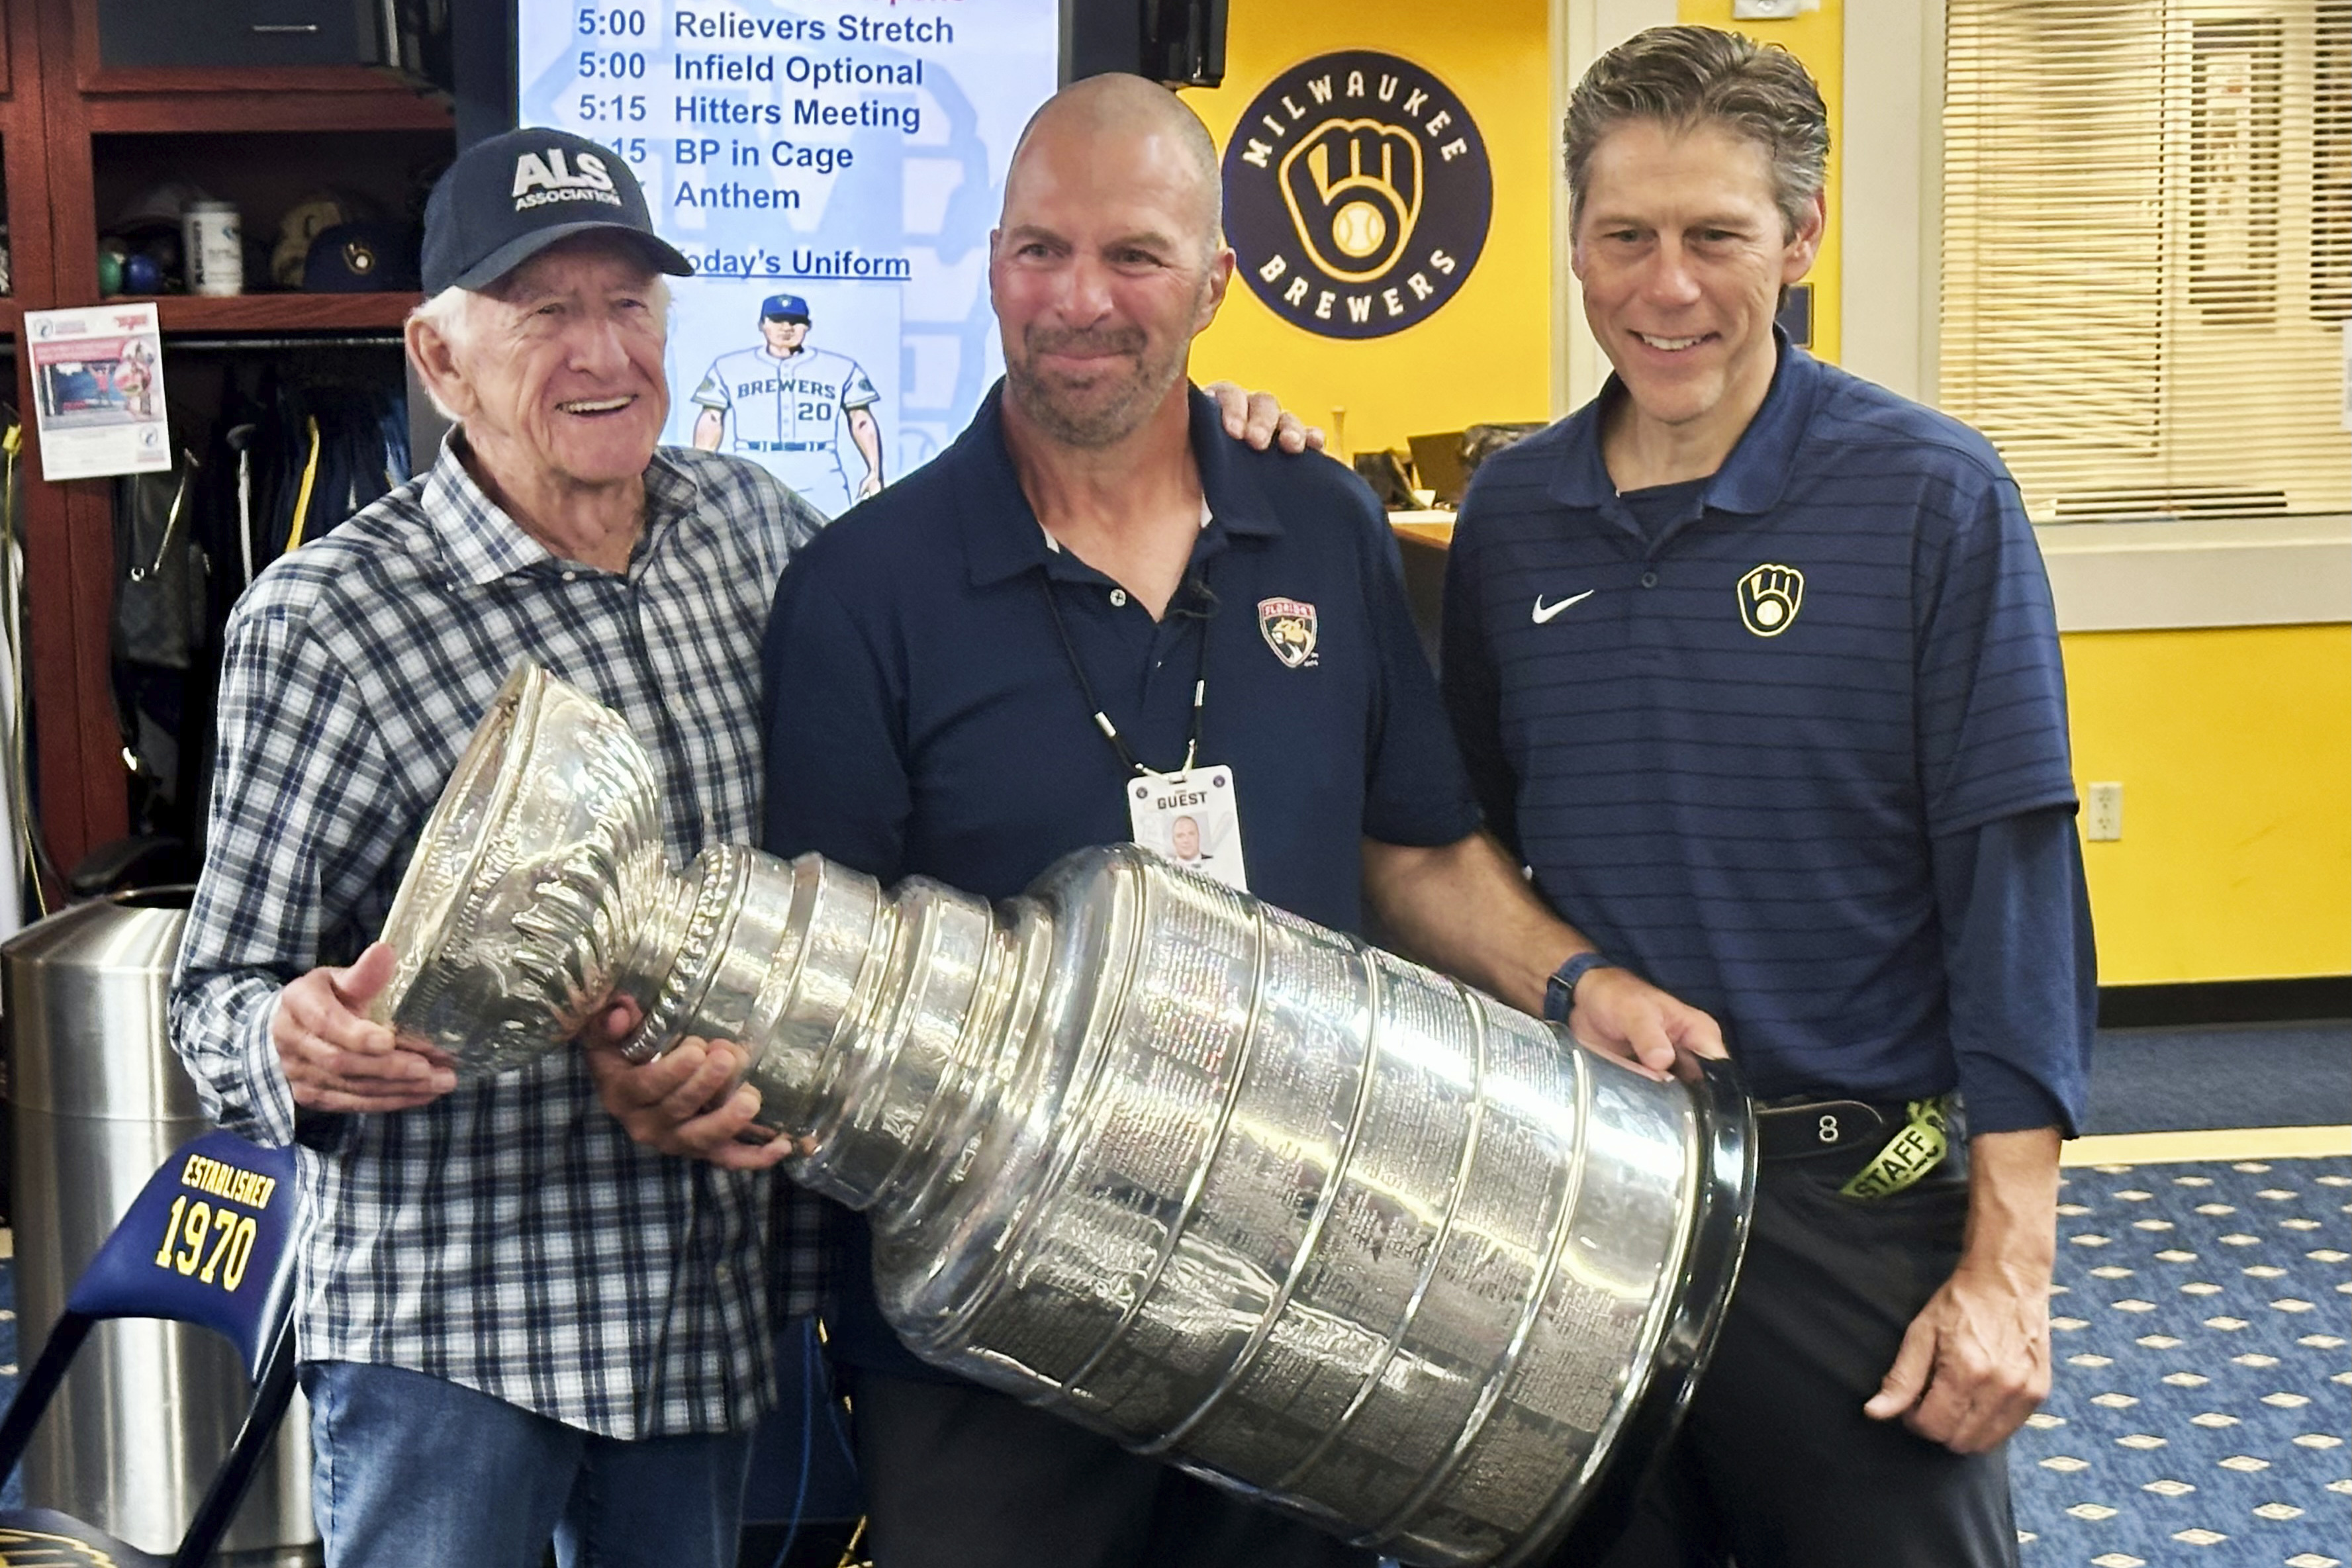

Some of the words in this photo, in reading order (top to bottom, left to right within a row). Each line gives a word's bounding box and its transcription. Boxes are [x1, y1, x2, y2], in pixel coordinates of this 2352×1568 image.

[579, 9, 645, 36] 5:00
[675, 11, 825, 40] Relievers
[837, 14, 954, 43] Stretch
[579, 52, 645, 79] 5:00
[675, 54, 774, 81] Infield
[786, 56, 923, 90] Optional
[579, 94, 646, 121] 5:15
[675, 96, 782, 125] Hitters
[794, 99, 921, 134] Meeting
[1242, 70, 1468, 169] MILWAUKEE
[512, 147, 614, 198] ALS
[675, 138, 721, 164] BP
[731, 139, 759, 166] in
[772, 140, 853, 175] Cage
[515, 187, 623, 212] ASSOCIATION
[673, 180, 800, 209] Anthem
[679, 248, 781, 279] oday's
[793, 250, 911, 275] Uniform
[1258, 249, 1456, 323] BREWERS
[737, 379, 836, 400] BREWERS
[797, 402, 831, 421] 20
[1156, 791, 1207, 810] GUEST
[1818, 1115, 1839, 1142] 8
[1854, 1129, 1925, 1195] STAFF
[181, 1154, 276, 1210] ESTABLISHED
[154, 1195, 258, 1292] 1970
